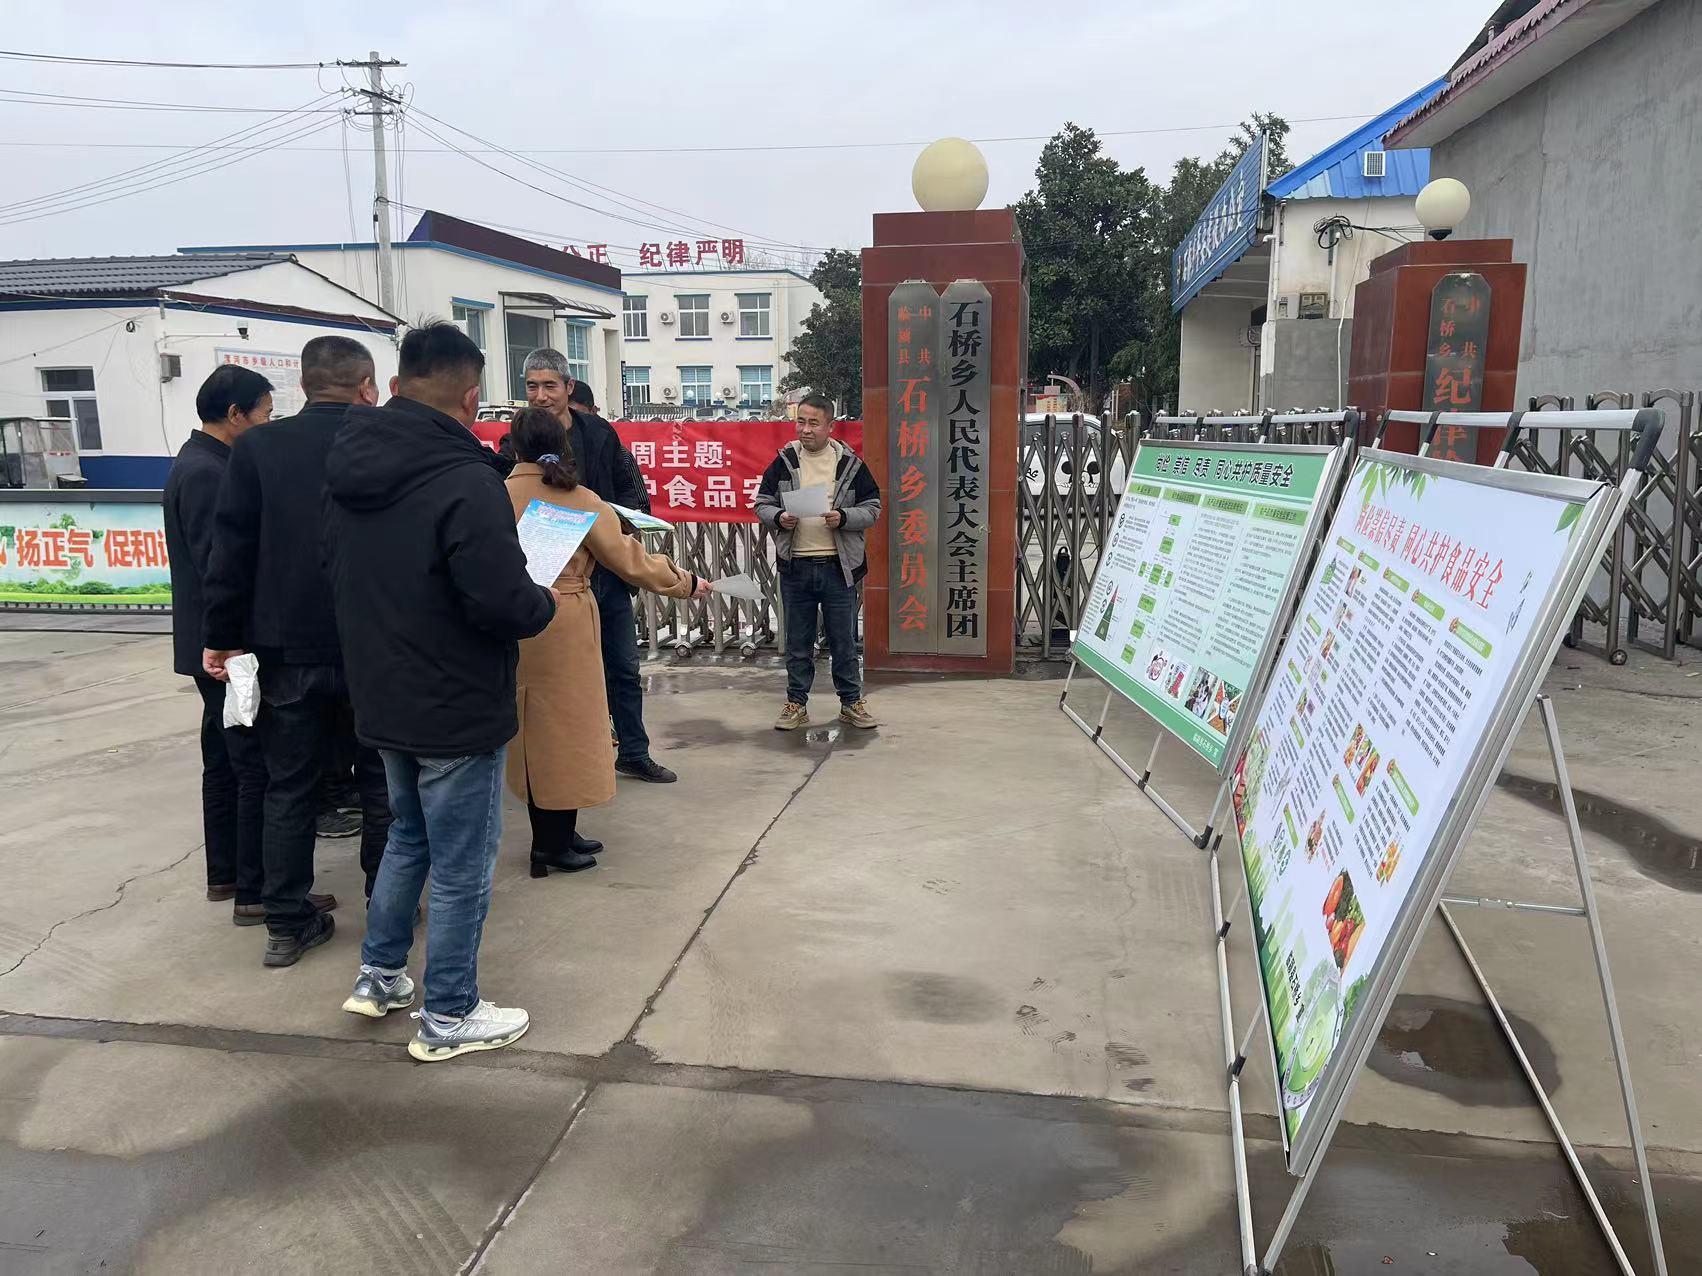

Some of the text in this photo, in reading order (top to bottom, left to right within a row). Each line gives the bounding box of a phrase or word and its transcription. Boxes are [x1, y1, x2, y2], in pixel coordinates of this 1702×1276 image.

[640, 238, 745, 267] 纪律严明
[918, 304, 932, 365] 中共
[1439, 297, 1457, 357] 石桥乡
[946, 300, 983, 638] 石桥乡人民代表大会主席团
[1193, 457, 1211, 478] 尽责
[1214, 458, 1295, 488] 同心共护质量安全
[896, 376, 931, 631] 石桥乡委员会
[16, 528, 94, 567] 扬正气
[1400, 522, 1504, 610] 同心共护食品安全
